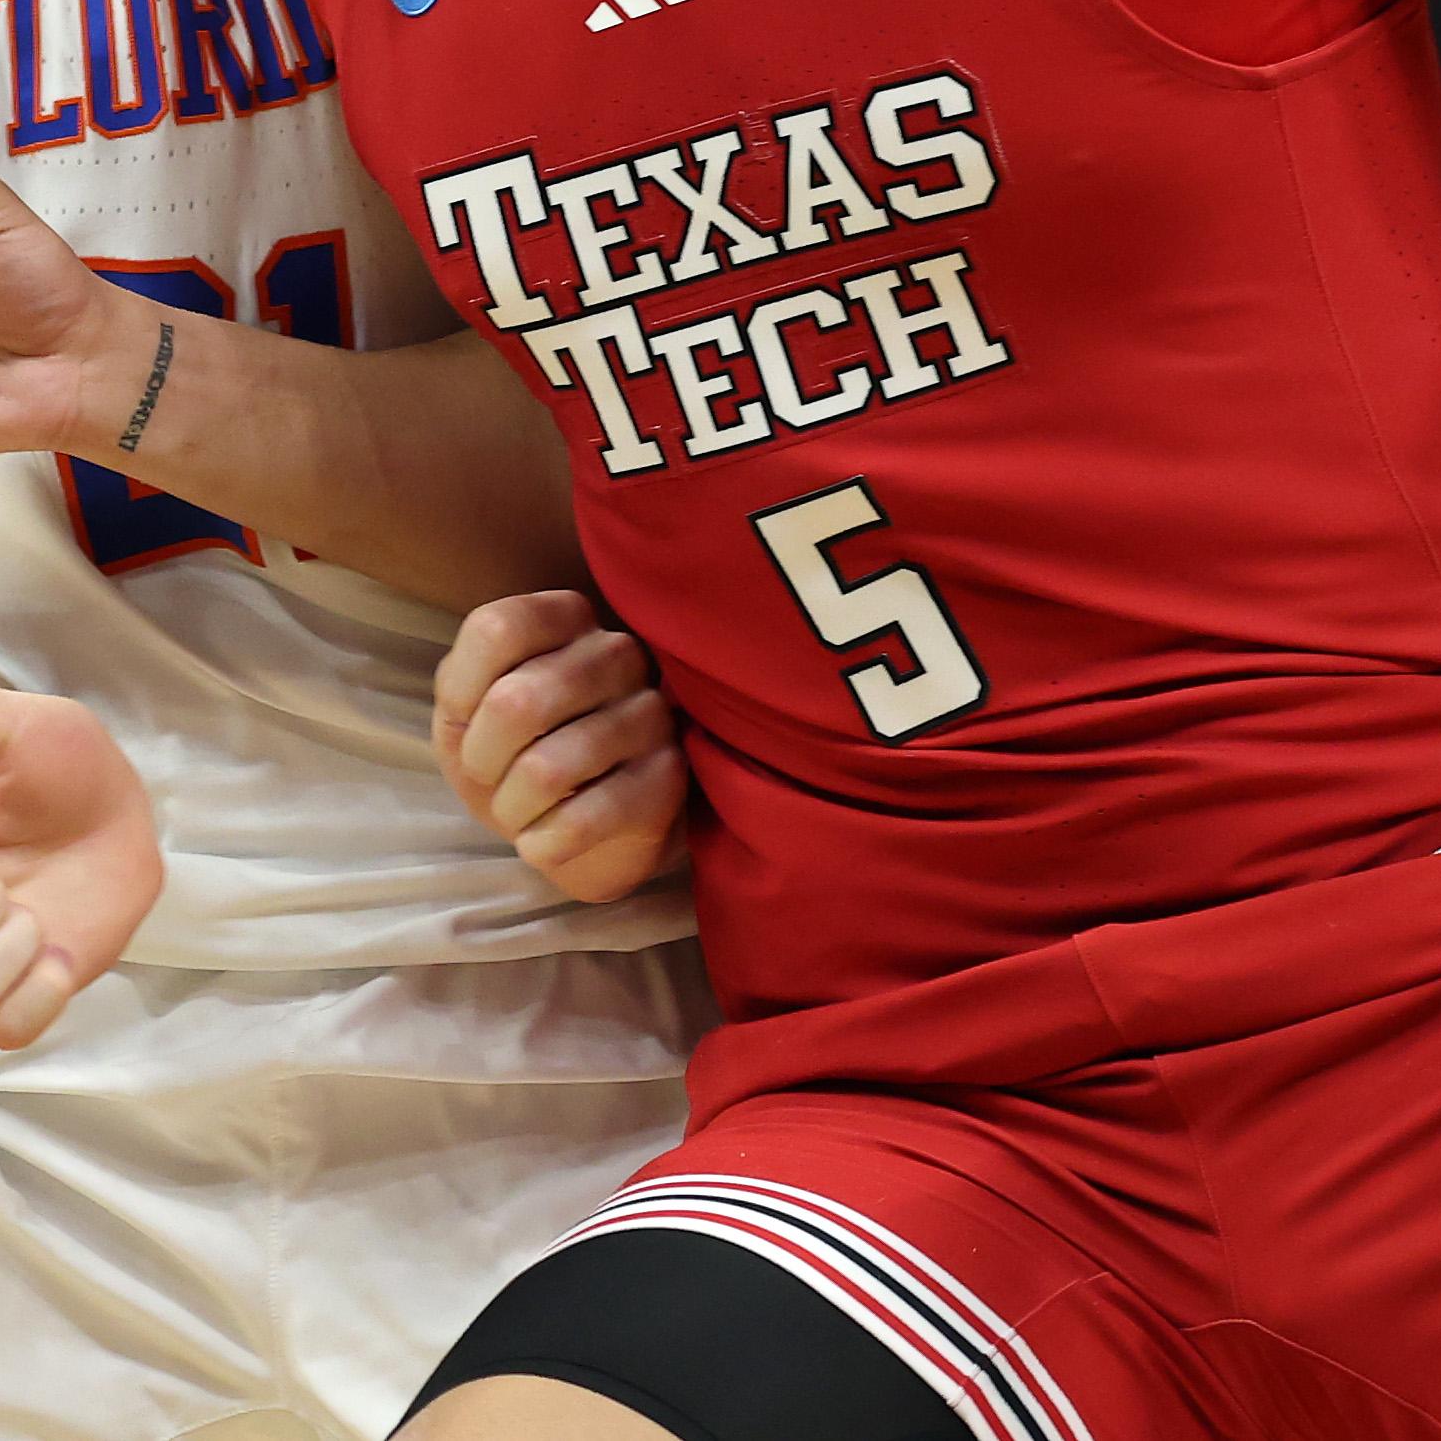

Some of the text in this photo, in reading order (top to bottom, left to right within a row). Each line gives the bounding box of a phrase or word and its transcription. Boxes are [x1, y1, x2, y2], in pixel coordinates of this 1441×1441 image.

[420, 68, 1001, 331] TEXAS
[520, 246, 1013, 478] TECH
[749, 475, 992, 745] 5
